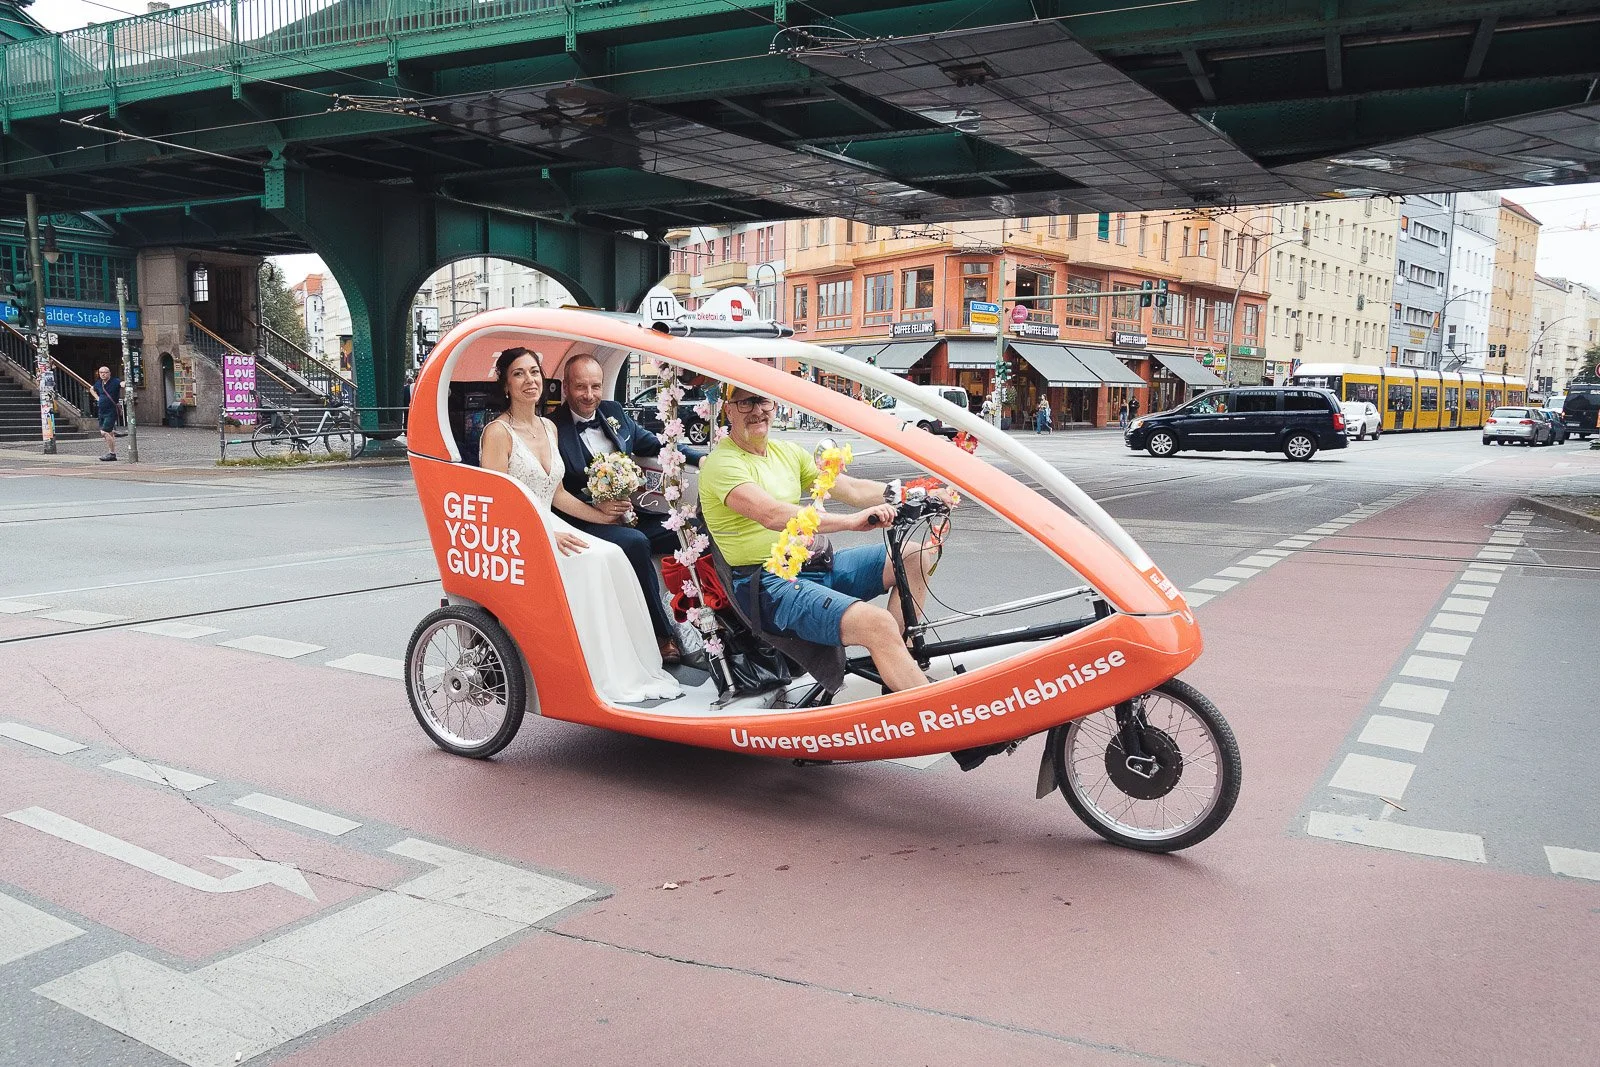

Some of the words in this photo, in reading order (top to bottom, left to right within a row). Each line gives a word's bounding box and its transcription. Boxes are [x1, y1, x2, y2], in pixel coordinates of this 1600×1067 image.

[5, 306, 74, 322] Ebalder
[77, 311, 111, 324] Straße
[656, 301, 669, 316] 41
[225, 356, 255, 365] TACO
[225, 368, 255, 378] LOVE
[226, 381, 255, 391] TACO
[443, 491, 493, 523] GET
[444, 519, 521, 556] YOUR
[446, 547, 525, 586] GUIDE
[730, 719, 915, 753] Unvergessliche
[918, 650, 1126, 733] Reiseerlebnisse
